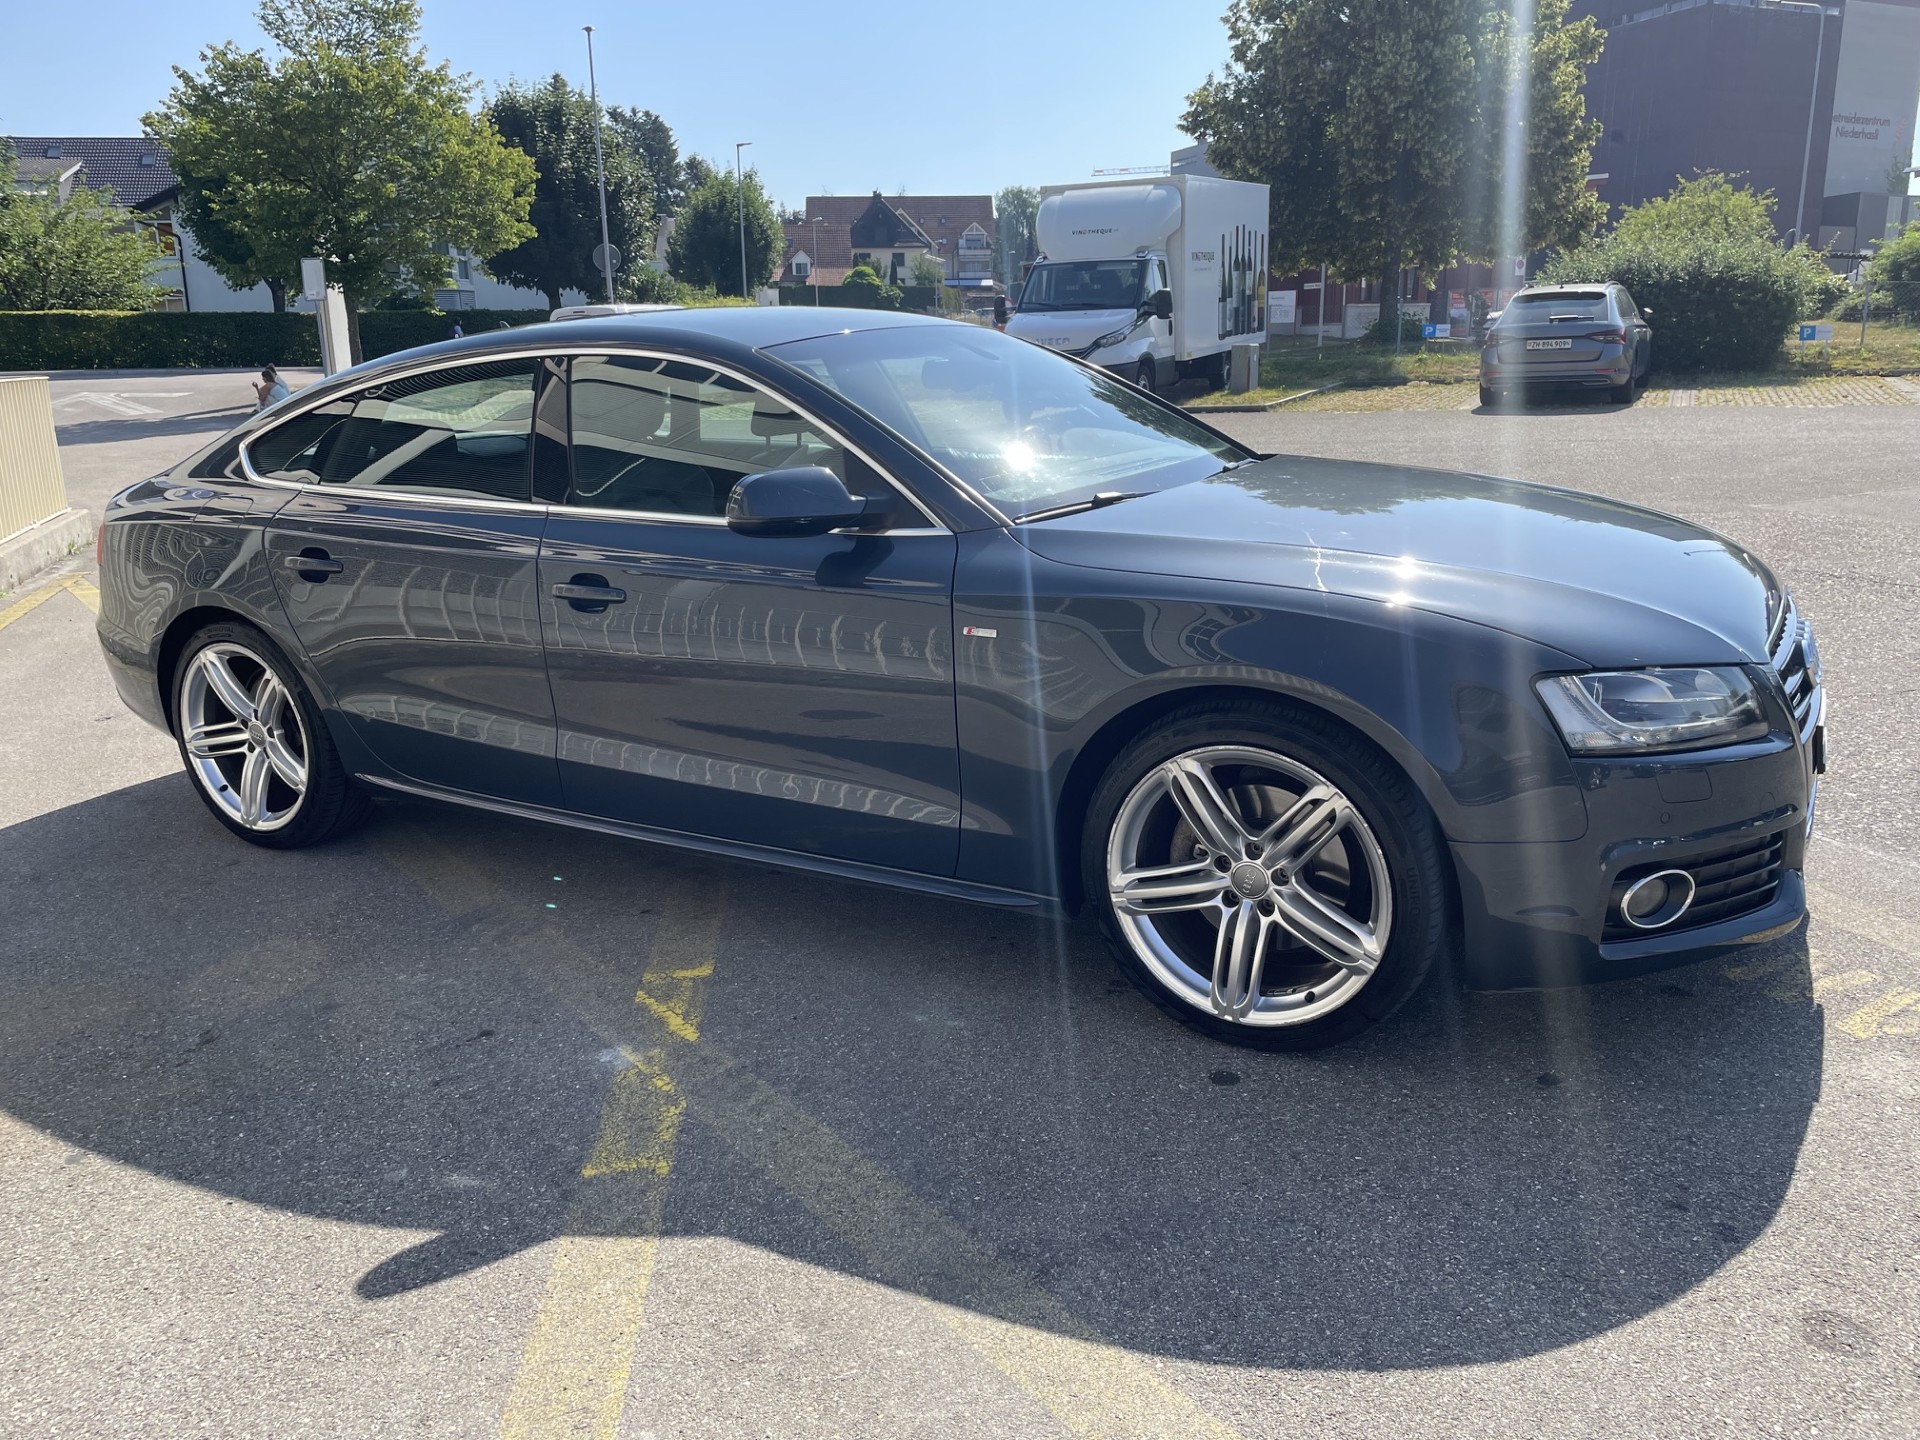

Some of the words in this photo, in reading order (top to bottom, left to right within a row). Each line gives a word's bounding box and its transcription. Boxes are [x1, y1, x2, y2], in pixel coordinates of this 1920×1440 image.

[1833, 112, 1890, 127] etreidezentrum
[1425, 327, 1434, 335] P
[1803, 327, 1812, 338] P
[1531, 341, 1541, 349] ZH
